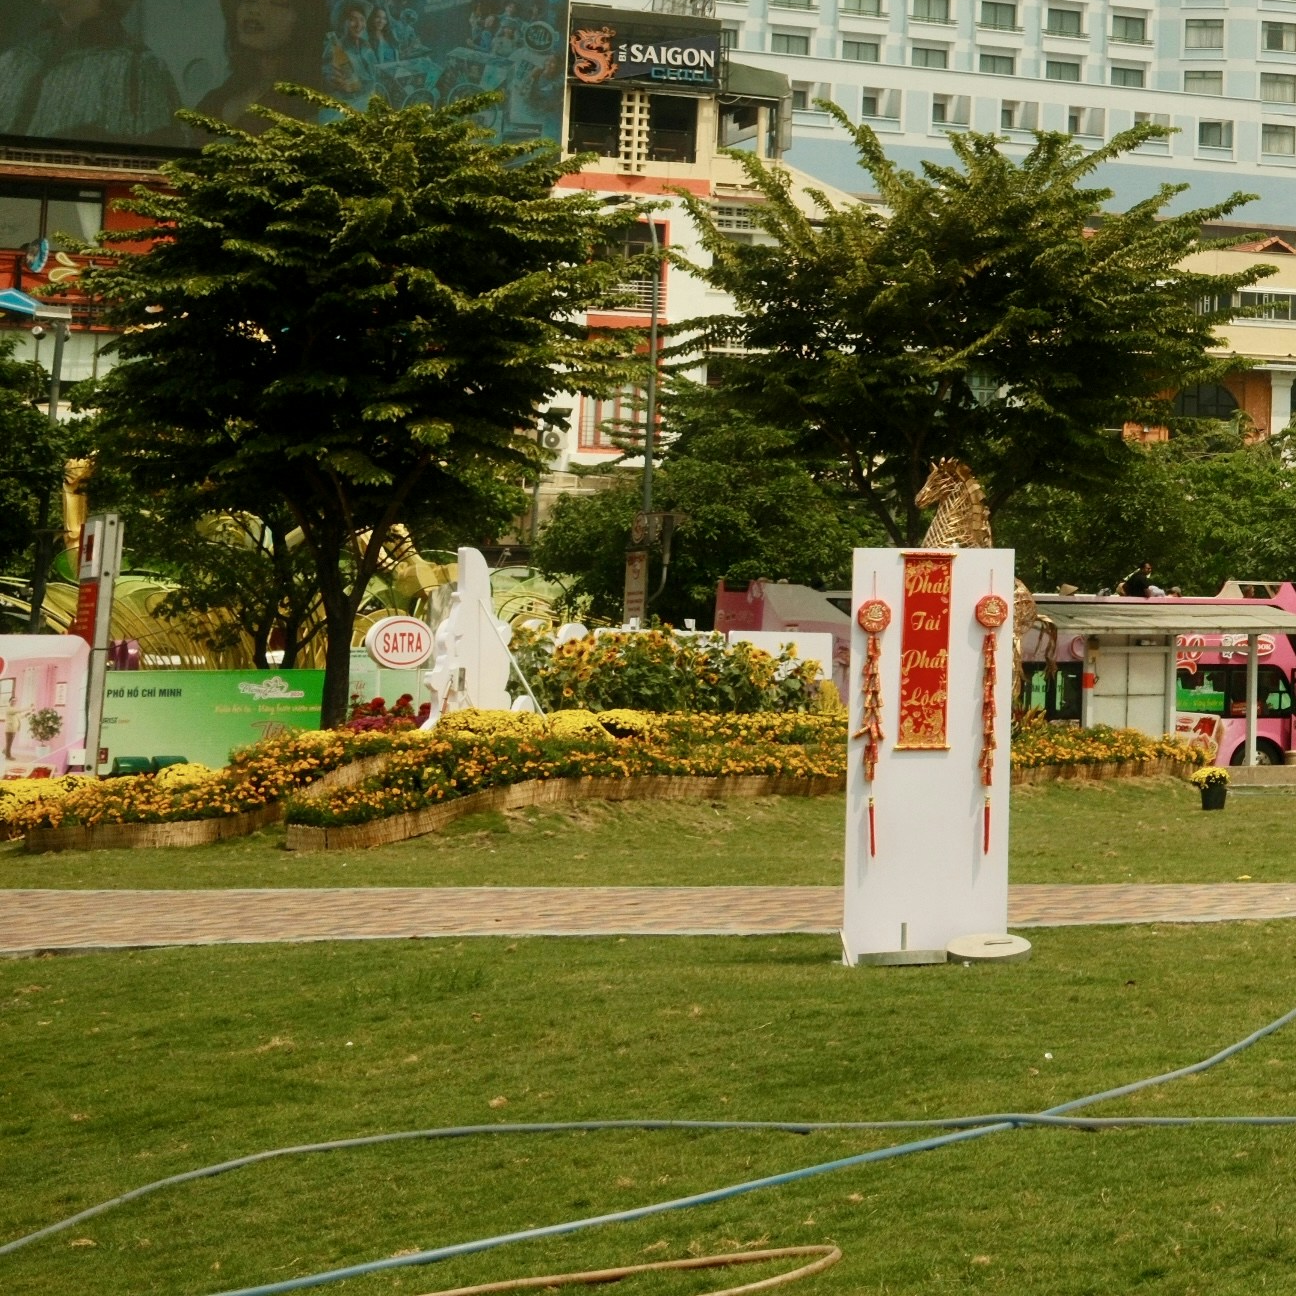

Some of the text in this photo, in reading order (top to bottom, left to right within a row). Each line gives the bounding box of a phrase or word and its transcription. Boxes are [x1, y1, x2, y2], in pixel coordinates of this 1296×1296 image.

[618, 43, 628, 62] BIA
[630, 44, 715, 68] SAIGON
[911, 611, 941, 631] Tài
[383, 632, 423, 653] SATRA
[106, 685, 182, 698] PHỐ HỒ CHÍ MINH
